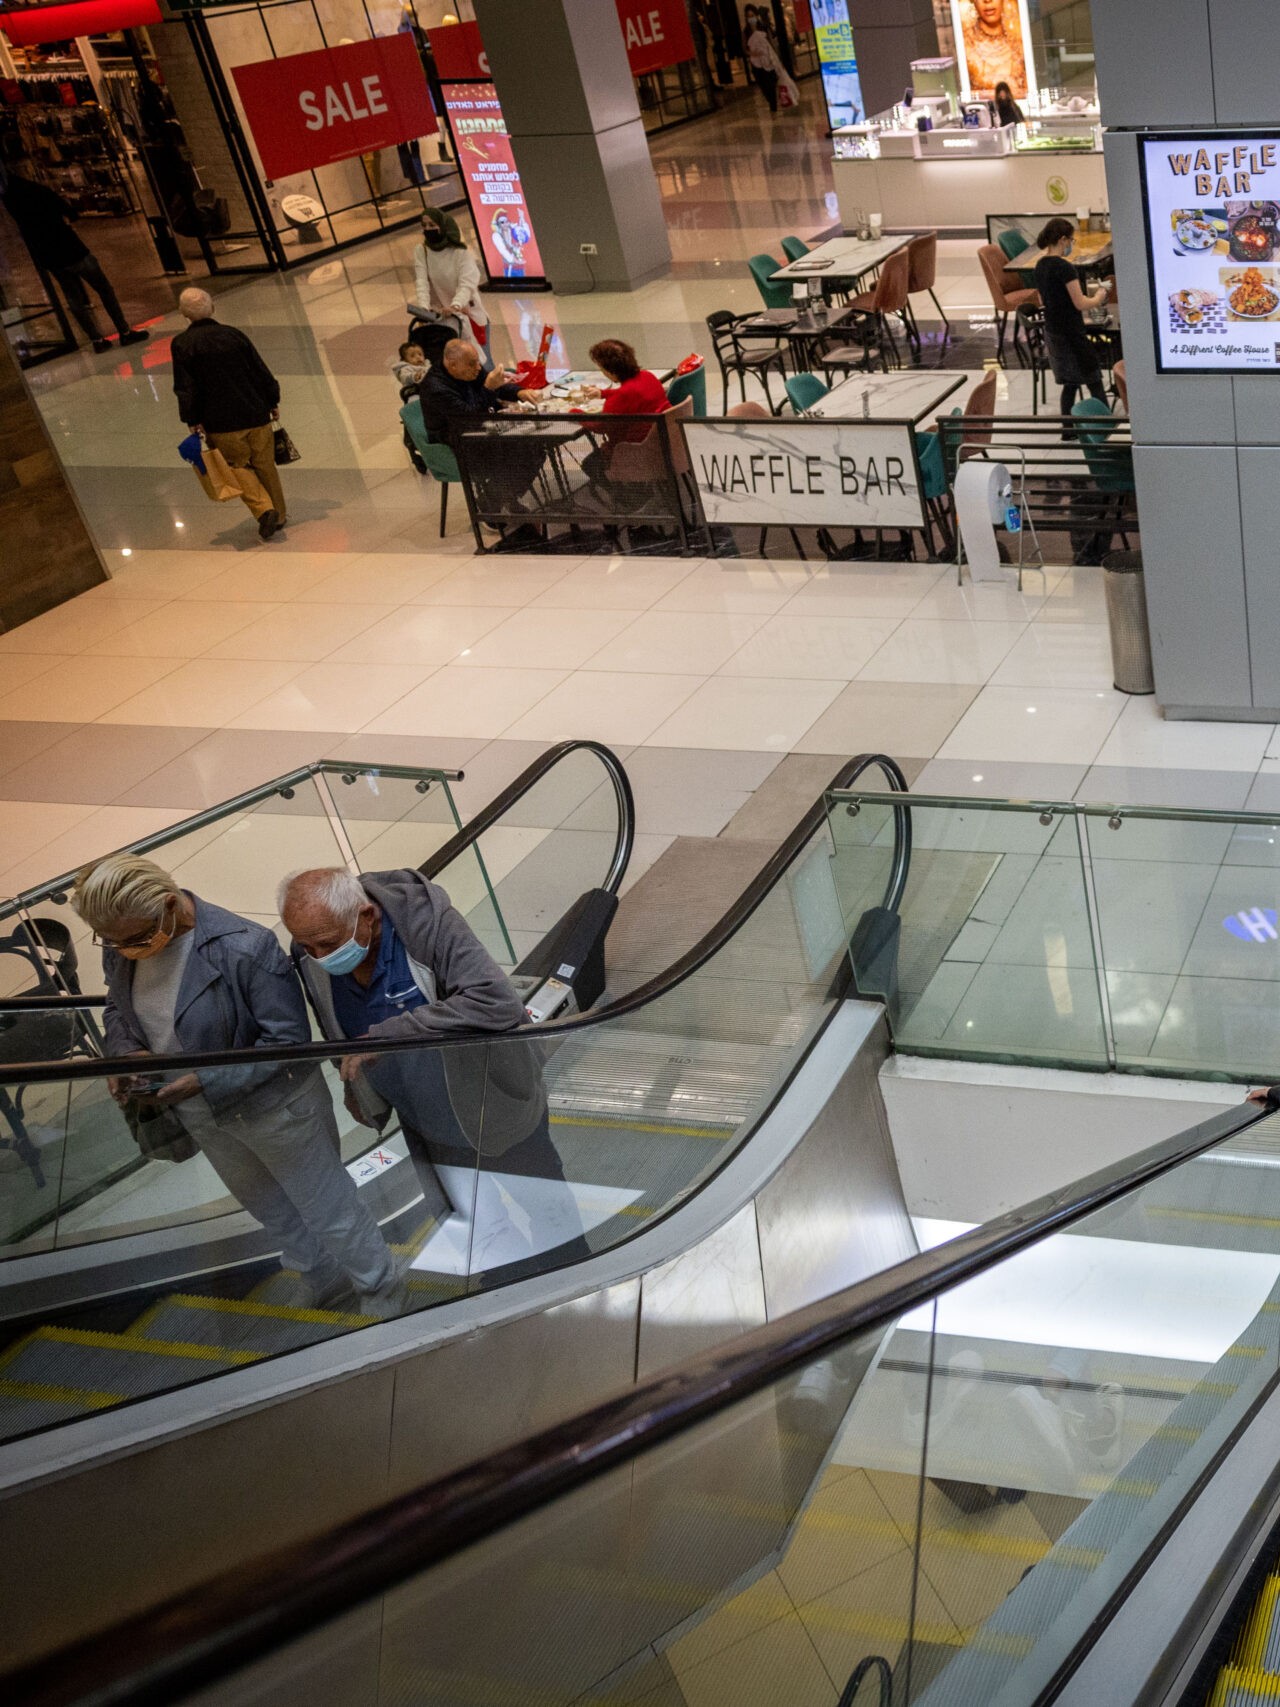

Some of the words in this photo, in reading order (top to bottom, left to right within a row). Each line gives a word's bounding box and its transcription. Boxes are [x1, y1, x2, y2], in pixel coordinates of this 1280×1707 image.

[625, 10, 664, 50] ALE
[299, 75, 388, 131] SALE
[475, 101, 500, 109] פיראט
[1168, 144, 1277, 175] WAFFLE
[1196, 172, 1251, 197] BAR
[1214, 344, 1242, 356] Coffee
[1243, 344, 1270, 354] House
[701, 454, 824, 494] WAFFLE
[839, 456, 906, 496] BAR
